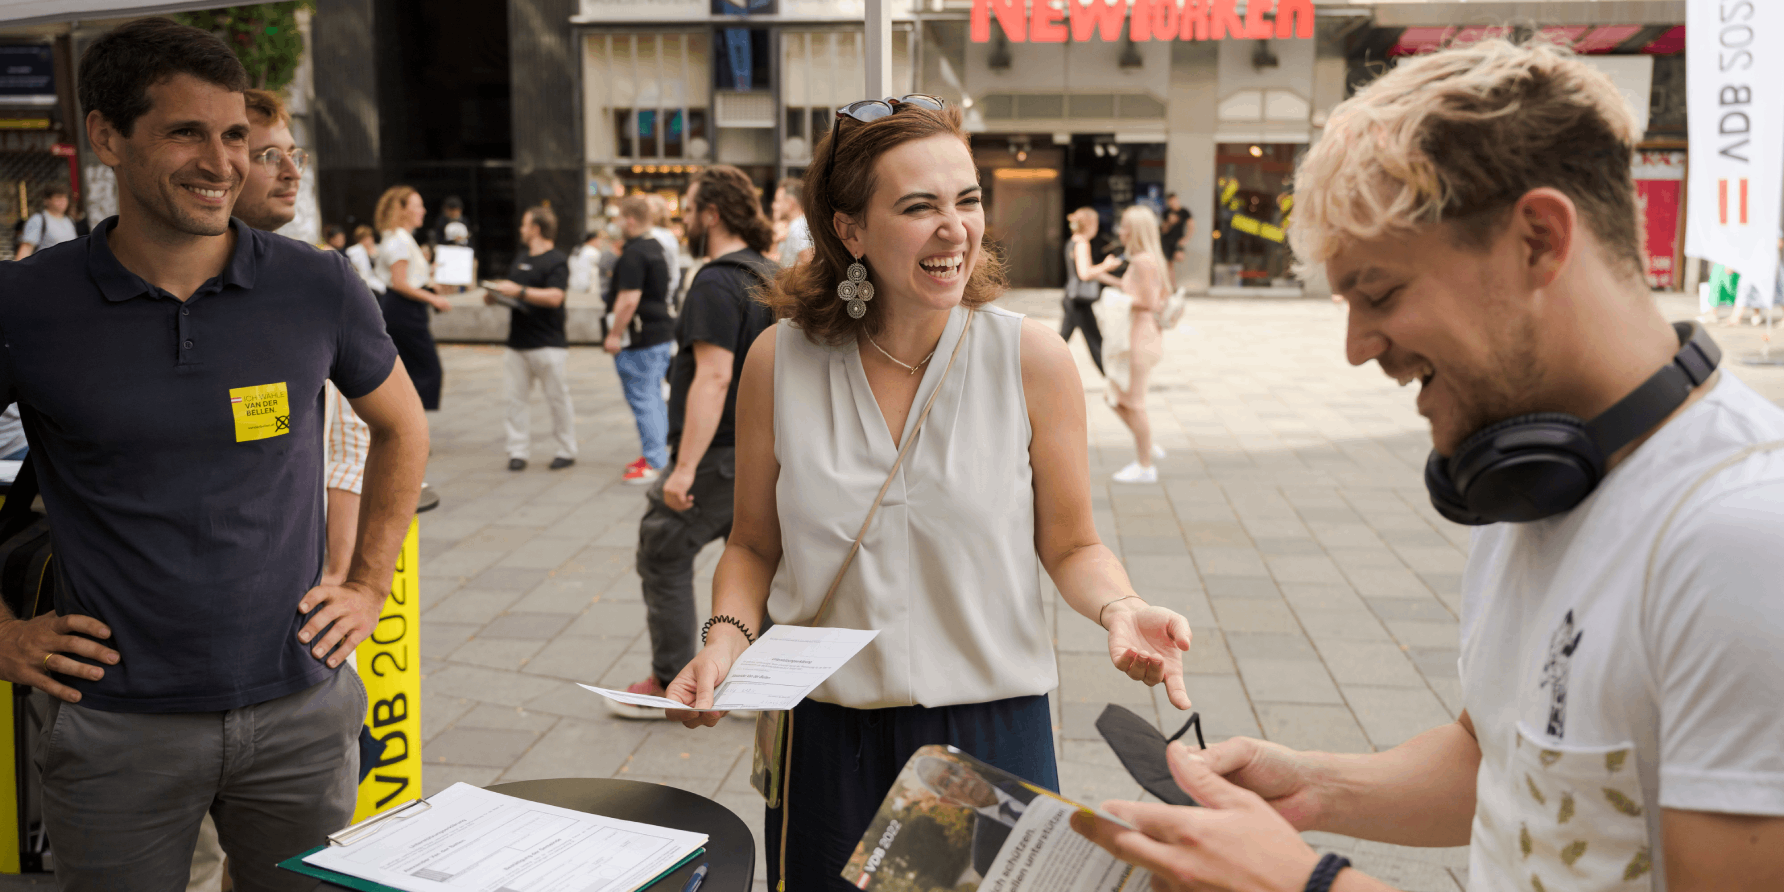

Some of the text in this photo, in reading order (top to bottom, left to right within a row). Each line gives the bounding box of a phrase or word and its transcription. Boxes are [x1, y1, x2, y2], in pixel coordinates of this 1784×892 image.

[373, 692, 409, 810] VDB
[864, 819, 902, 872] VDB 2022
